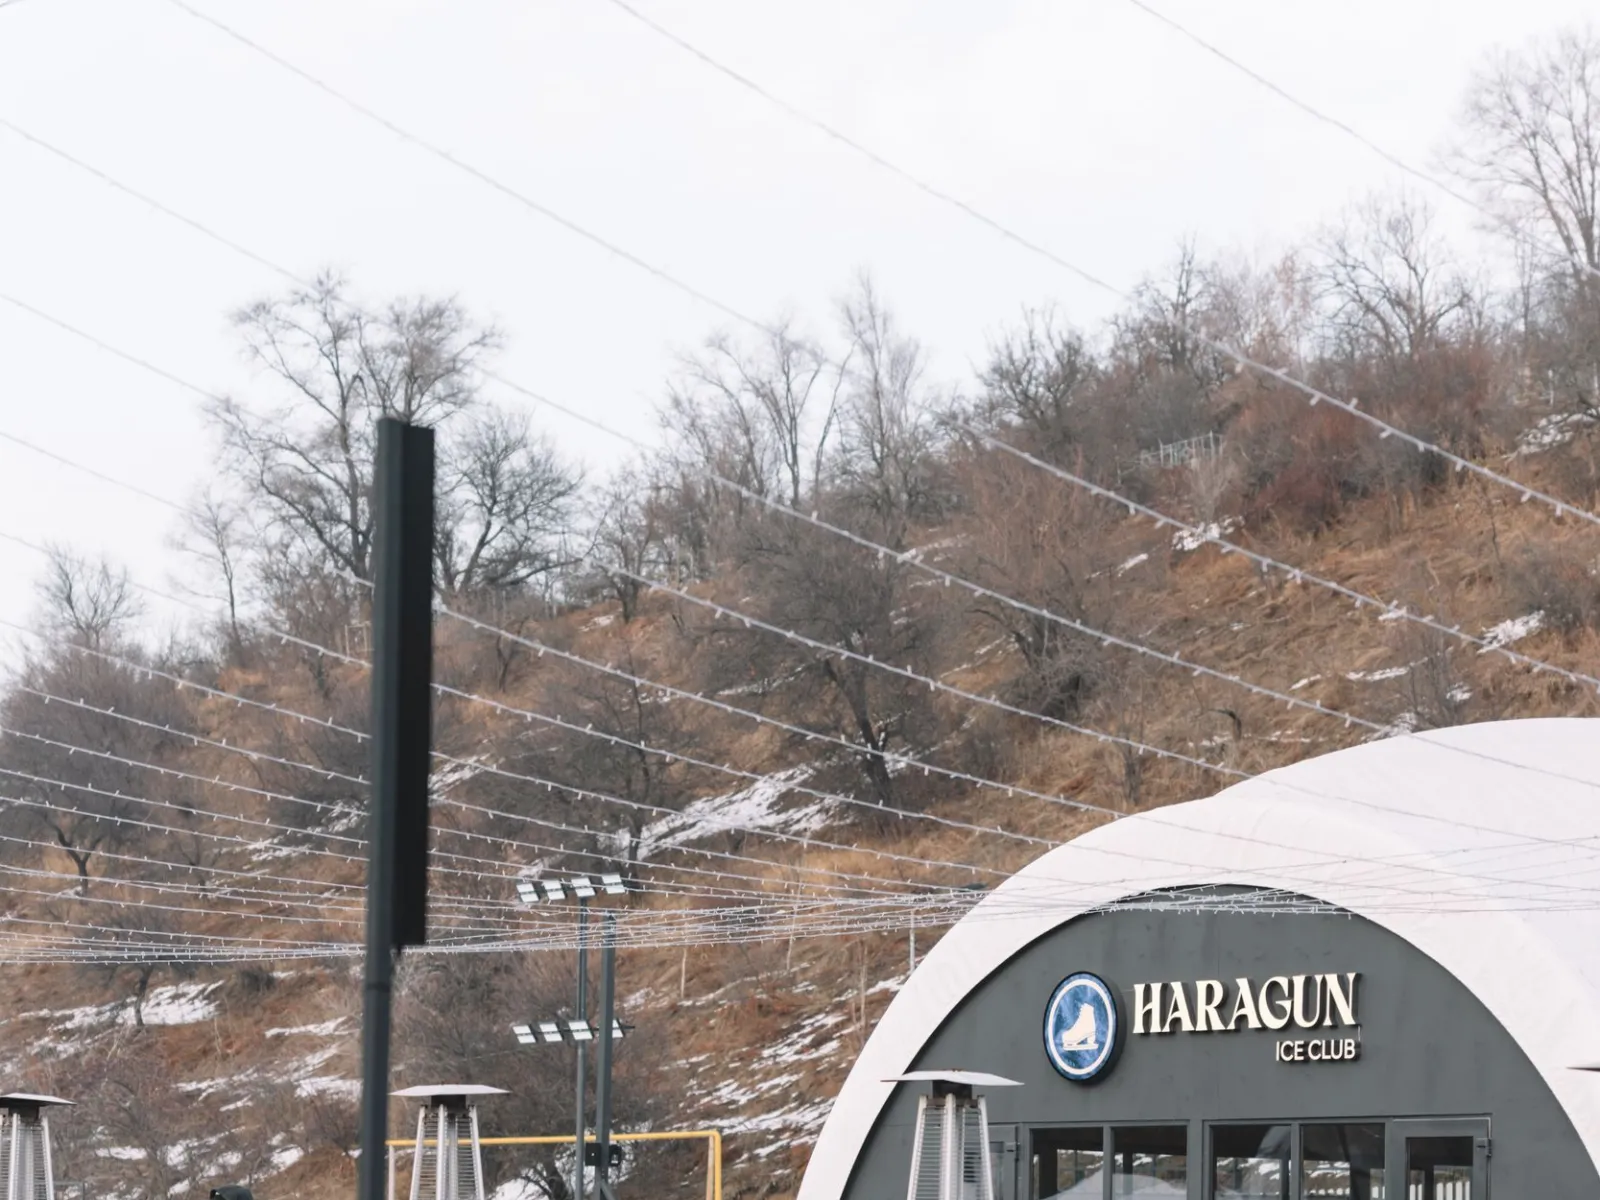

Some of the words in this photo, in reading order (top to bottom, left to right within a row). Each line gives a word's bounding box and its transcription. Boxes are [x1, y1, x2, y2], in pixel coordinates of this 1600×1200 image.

[1133, 972, 1358, 1034] HARAGUN
[1276, 1040, 1304, 1061] ICE
[1308, 1038, 1356, 1060] CLUB
